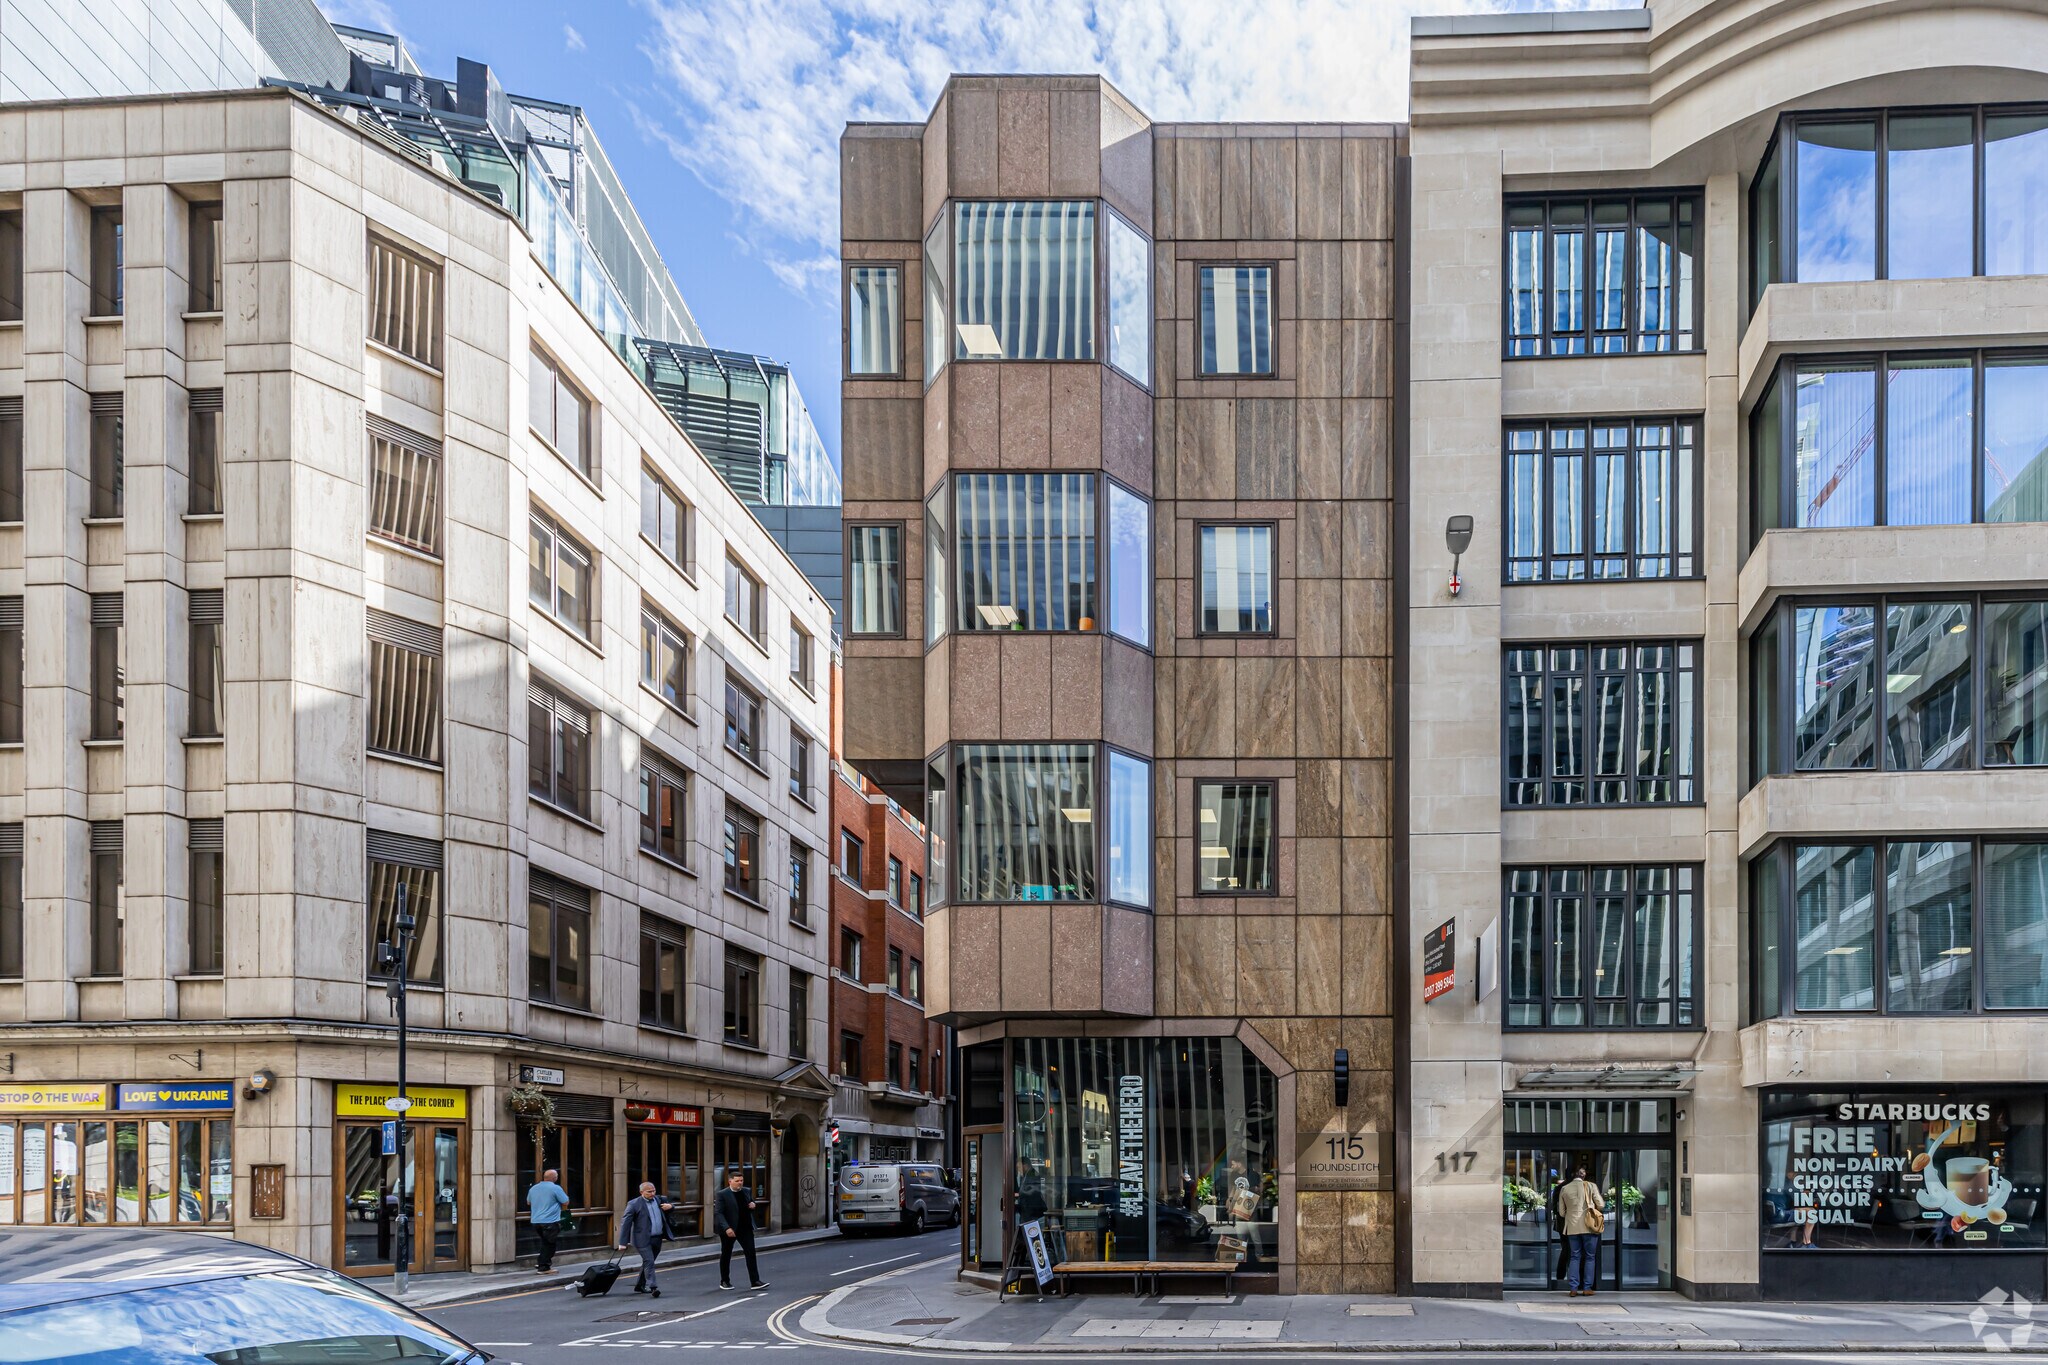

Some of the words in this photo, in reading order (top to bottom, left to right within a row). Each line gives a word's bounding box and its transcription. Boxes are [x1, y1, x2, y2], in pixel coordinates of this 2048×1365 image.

[1424, 985, 1434, 998] 0207
[1435, 979, 1443, 993] 399
[0, 1093, 30, 1102] STOP
[46, 1093, 69, 1102] THE
[71, 1093, 100, 1102] WAR
[124, 1092, 157, 1102] LOVE
[173, 1090, 228, 1101] UKRAINE
[349, 1095, 363, 1105] THE
[365, 1095, 386, 1106] PLACE
[414, 1097, 427, 1107] THE
[428, 1098, 455, 1108] CORNER
[673, 1110, 683, 1121] FOOD
[684, 1111, 688, 1122] IS
[688, 1112, 696, 1123] LIFE
[1839, 1103, 1990, 1121] STARBUCKS
[1119, 1075, 1143, 1218] #LEAVETHEHERD
[1794, 1126, 1875, 1154] FREE
[1326, 1137, 1364, 1160] 115
[1309, 1163, 1380, 1171] HOUNDSDITCH
[1435, 1151, 1478, 1172] 117
[1794, 1157, 1906, 1172] NON-DAIRY
[1793, 1174, 1874, 1189] CHOICES
[1794, 1192, 1814, 1206] IN
[1819, 1192, 1871, 1206] YOUR
[1794, 1209, 1854, 1224] USUAL
